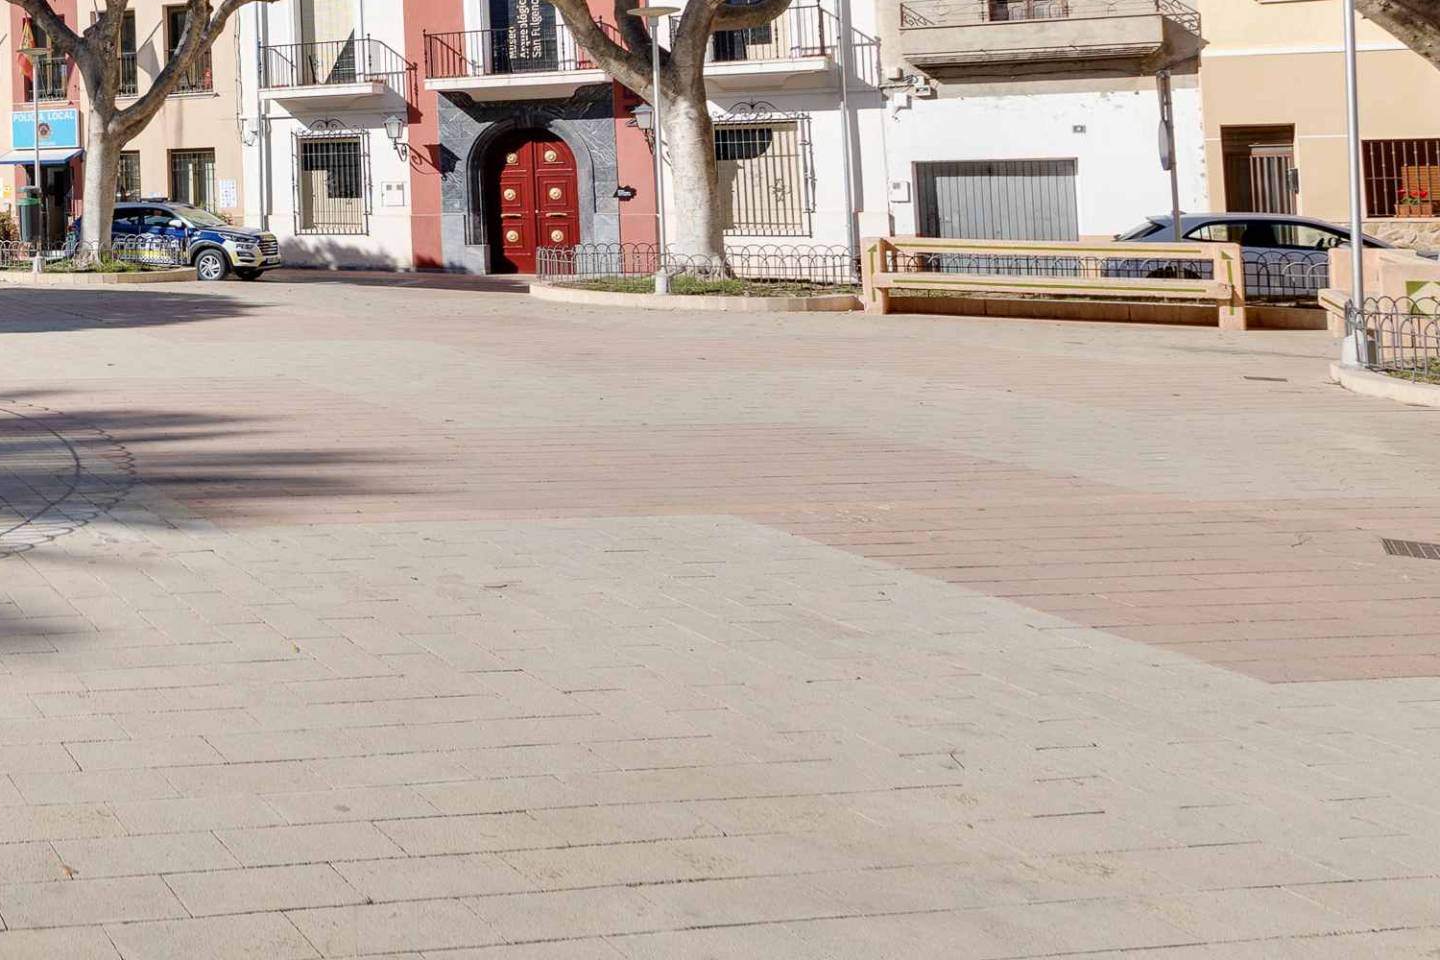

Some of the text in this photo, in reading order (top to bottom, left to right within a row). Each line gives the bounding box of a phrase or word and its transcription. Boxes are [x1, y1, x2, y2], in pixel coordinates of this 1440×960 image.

[508, 26, 517, 59] Museo
[532, 39, 542, 58] San
[13, 110, 75, 122] POLICA LOCAL
